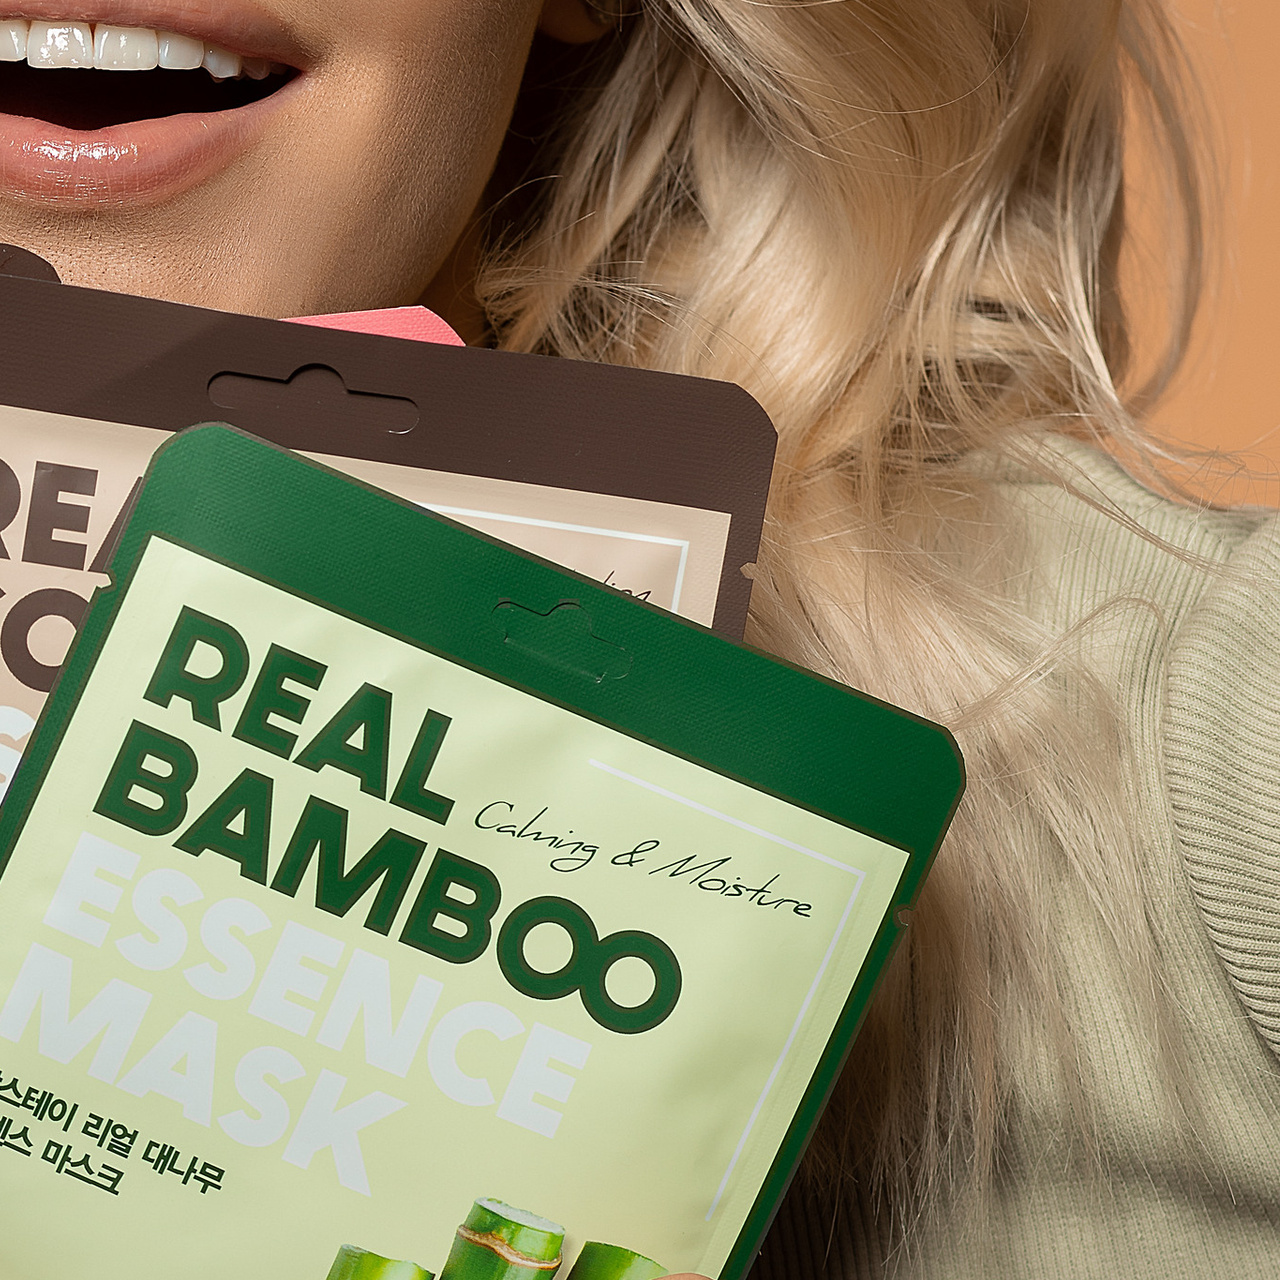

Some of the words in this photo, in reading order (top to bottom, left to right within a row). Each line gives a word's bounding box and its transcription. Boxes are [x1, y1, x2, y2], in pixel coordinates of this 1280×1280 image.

[143, 605, 455, 826] REAL
[92, 719, 682, 1035] BAMBOO
[474, 801, 599, 872] Calming
[611, 840, 660, 867] &
[649, 855, 813, 918] Moisture
[42, 831, 592, 1139] ESSENCE
[41, 1139, 124, 1196] 마스크
[81, 1112, 139, 1159] 리얼
[142, 1140, 226, 1195] 대나무
